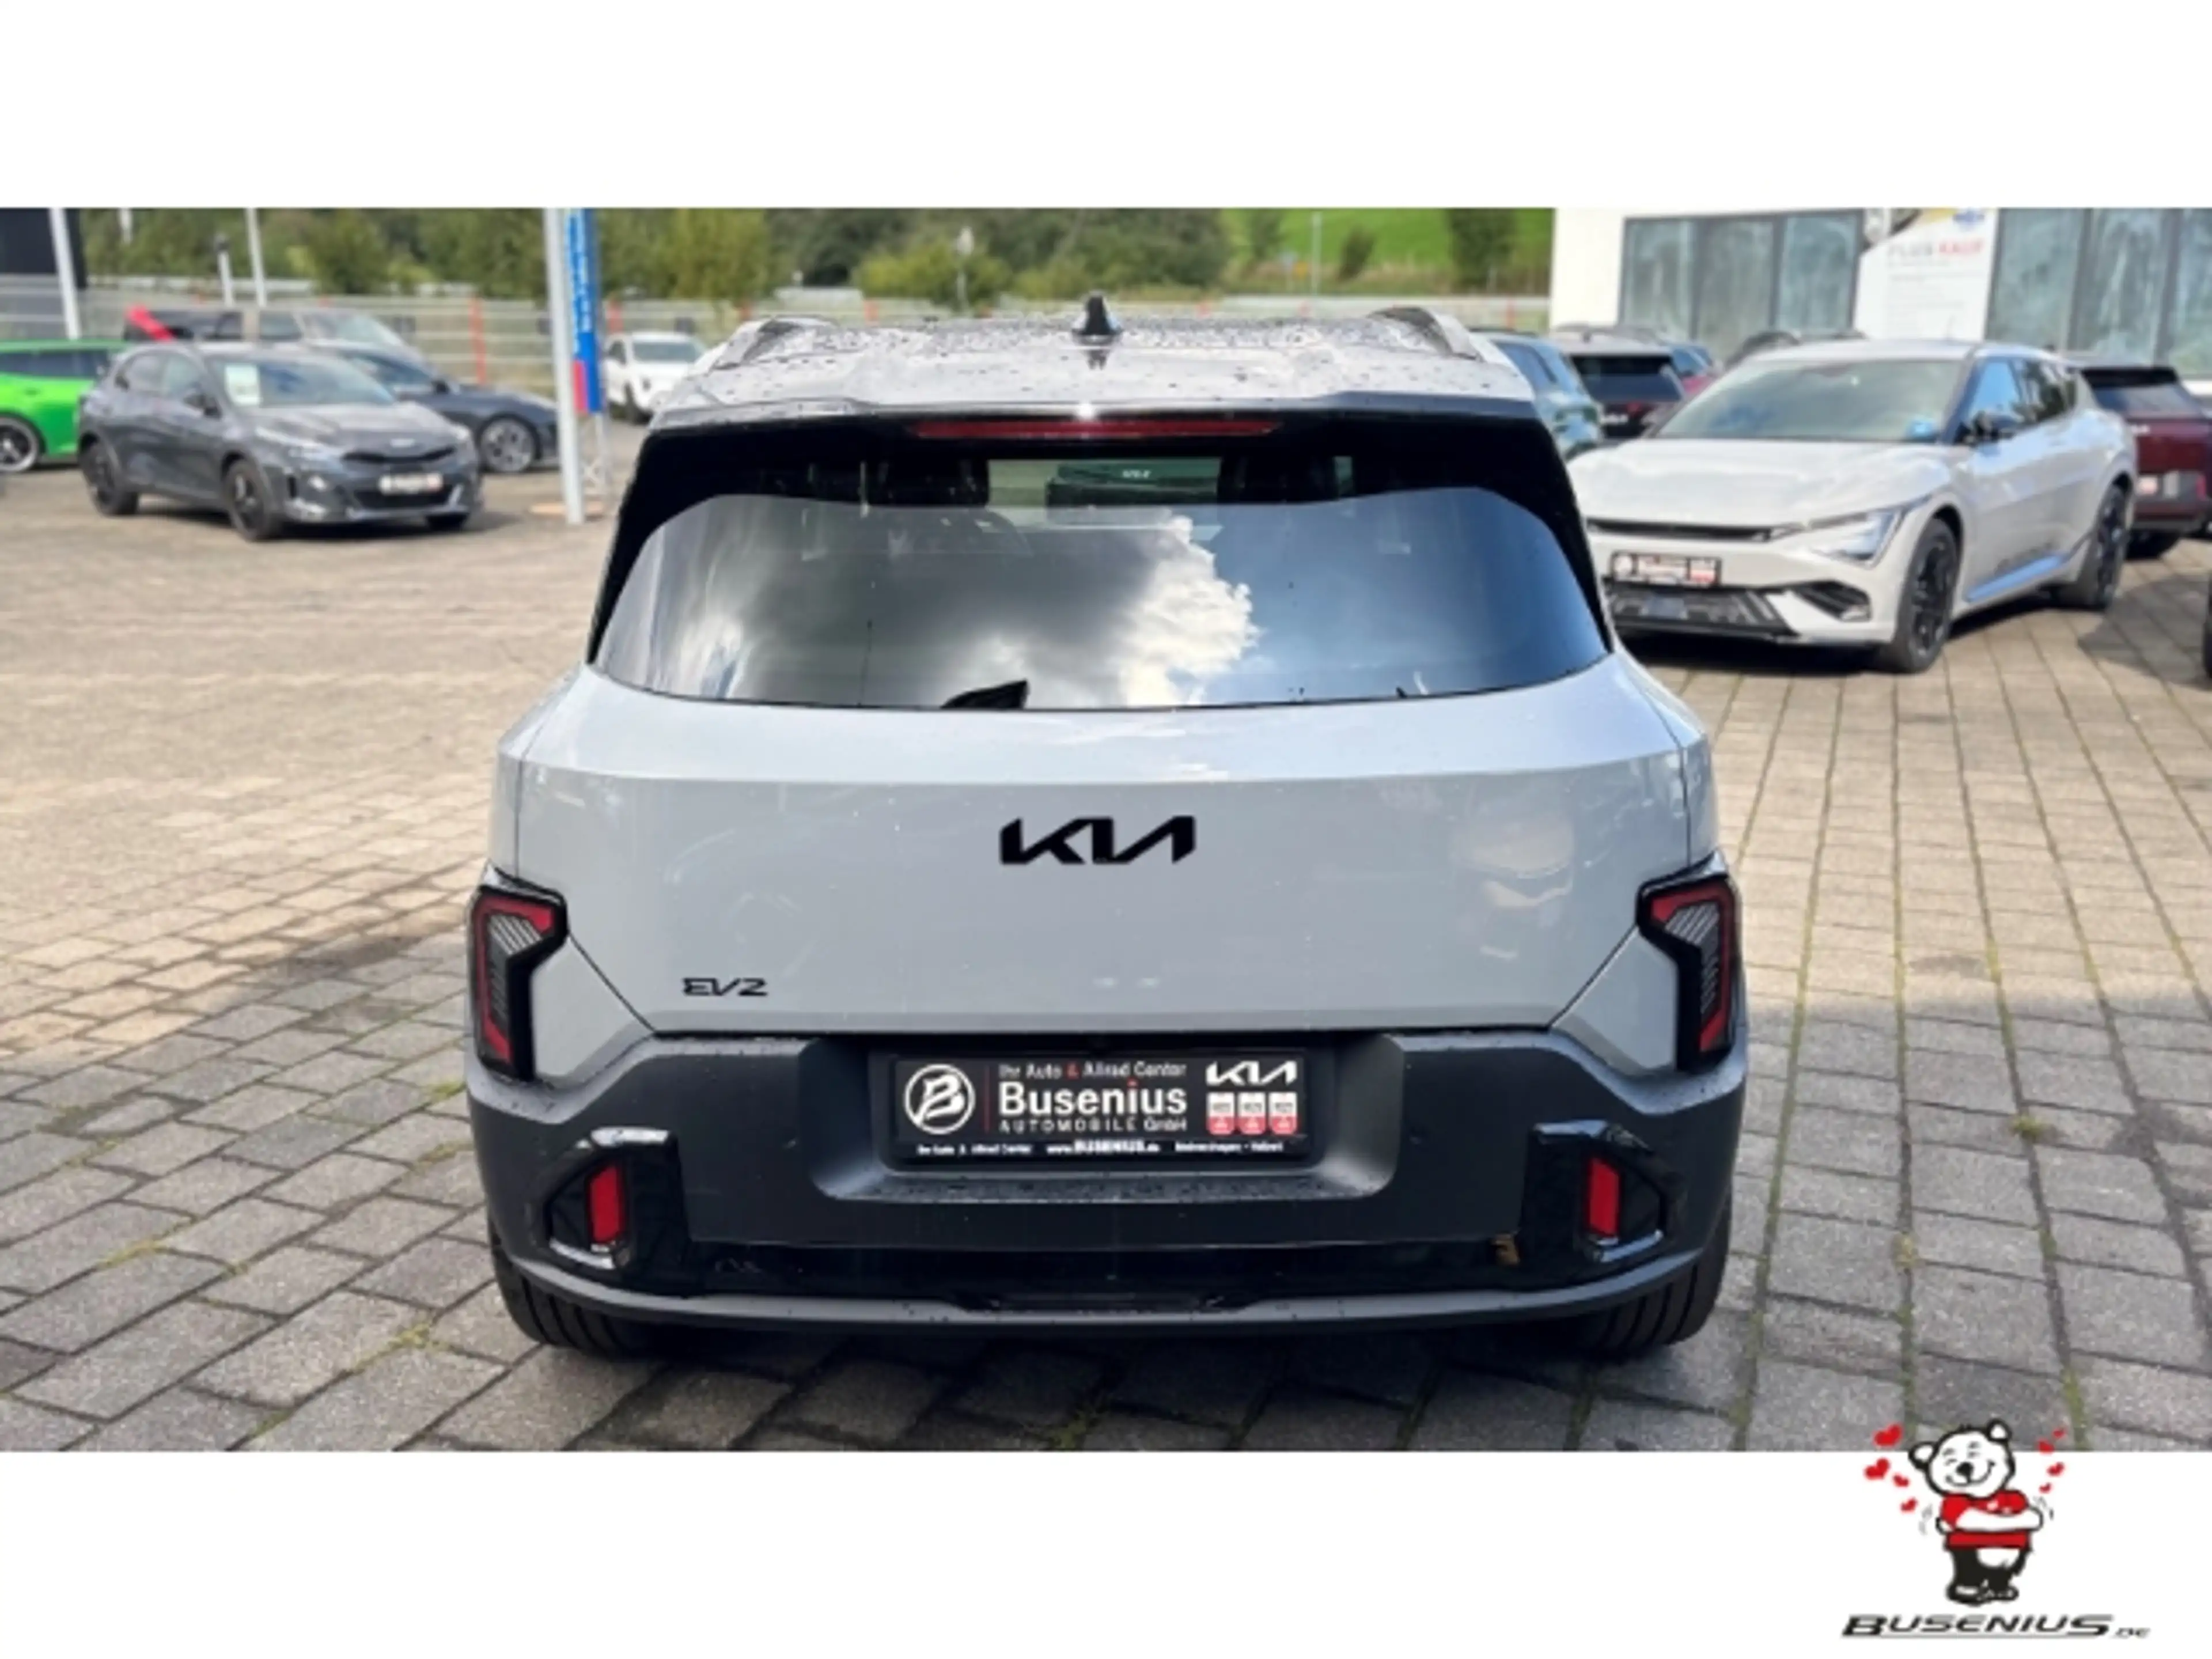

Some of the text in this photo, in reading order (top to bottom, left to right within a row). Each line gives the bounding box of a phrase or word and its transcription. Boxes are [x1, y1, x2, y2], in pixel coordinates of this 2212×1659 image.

[999, 816, 1195, 865] KIA
[683, 978, 767, 997] EV2
[1206, 1061, 1297, 1086] KIA
[999, 1078, 1187, 1116] Busenius
[999, 1117, 1187, 1132] AUTOMOBILE GmbH
